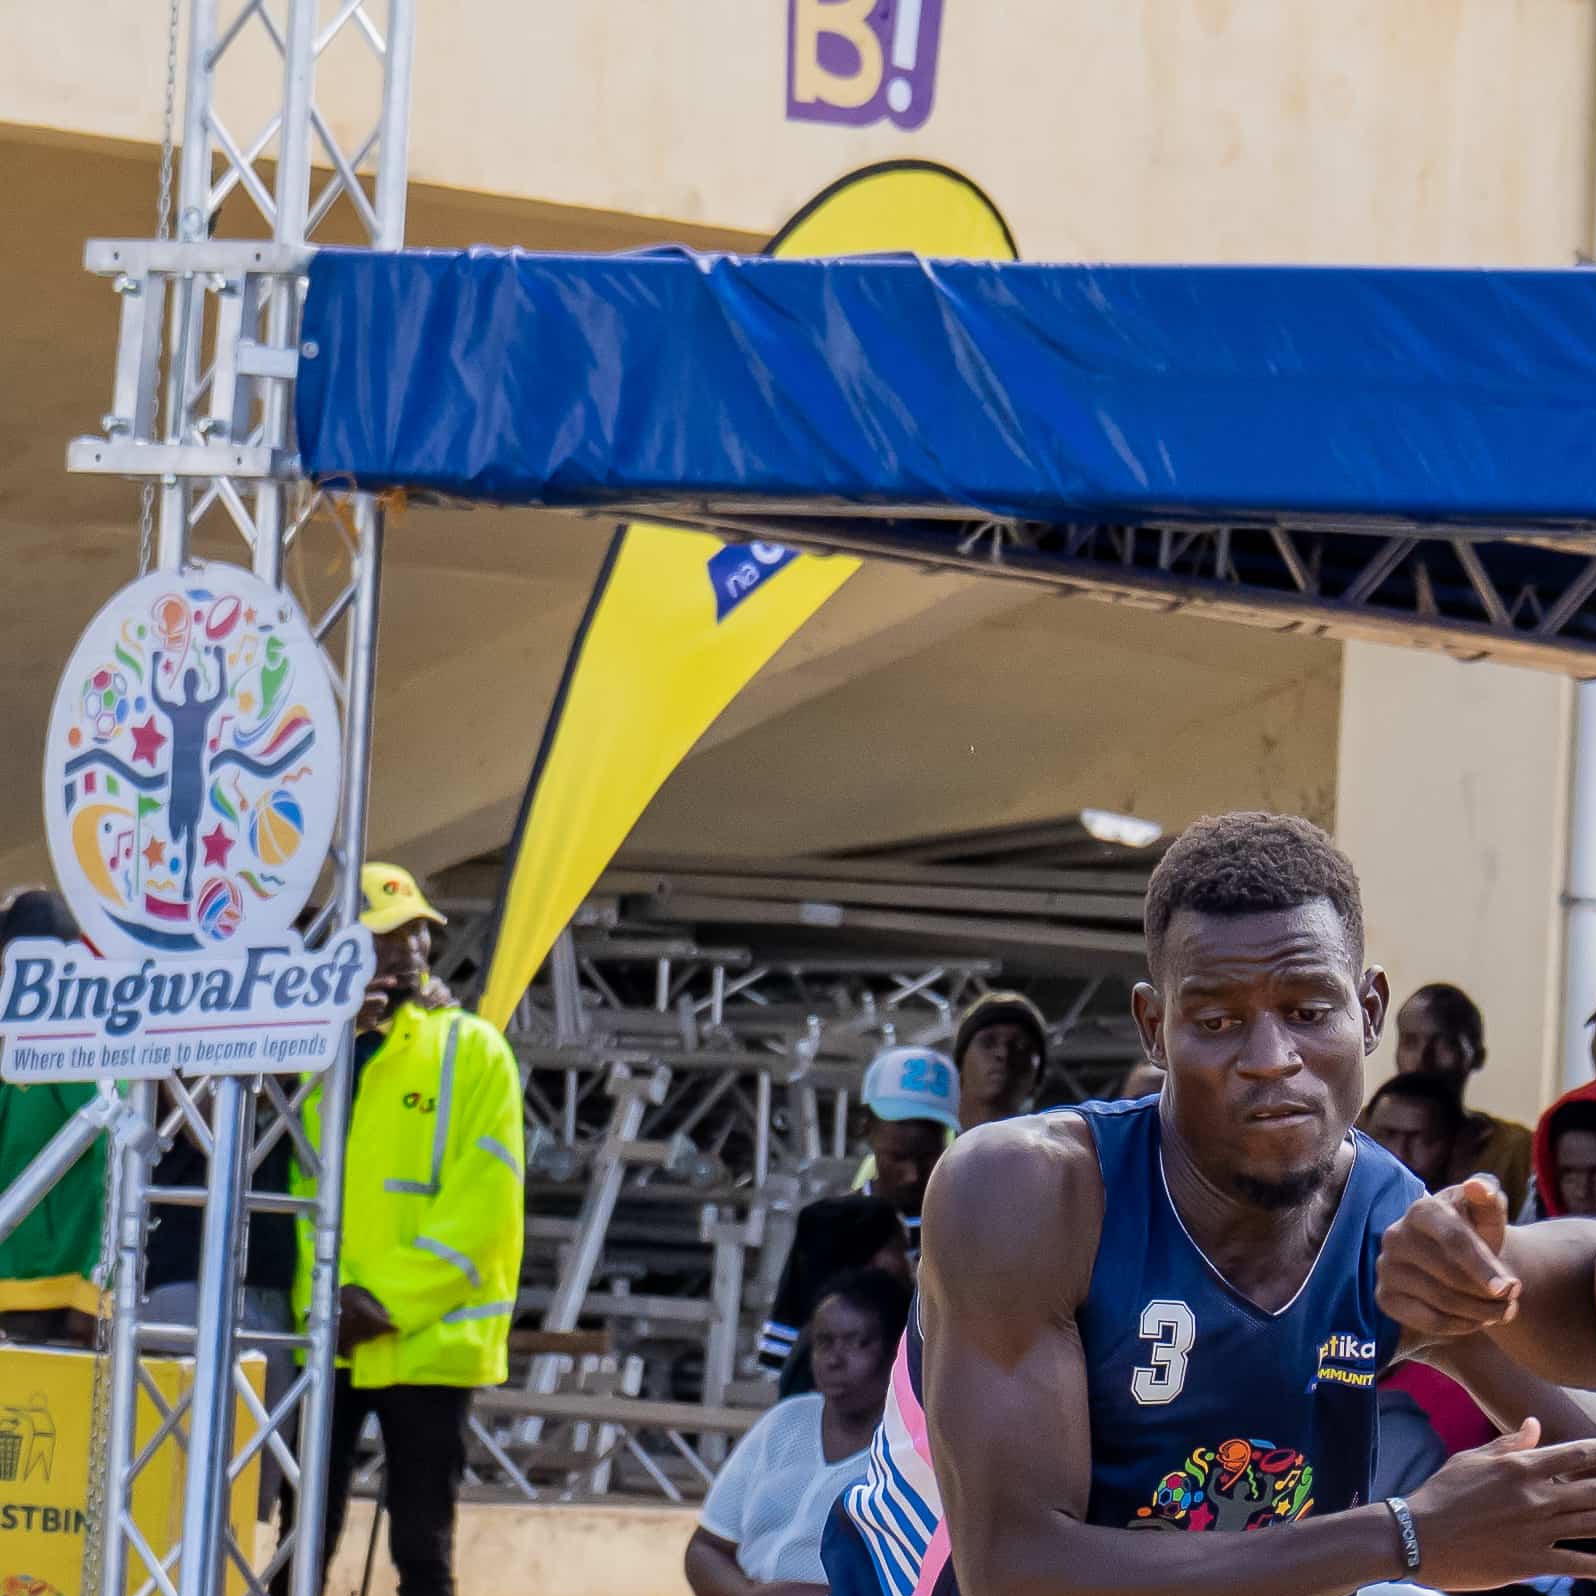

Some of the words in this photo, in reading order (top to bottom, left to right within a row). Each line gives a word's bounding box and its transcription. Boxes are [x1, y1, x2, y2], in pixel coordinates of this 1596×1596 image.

[1, 938, 363, 1038] BingwaFest
[14, 1046, 65, 1071] Where
[71, 1043, 97, 1067] the
[101, 1041, 136, 1067] best
[142, 1043, 171, 1065] rise
[177, 1041, 191, 1063] to
[196, 1040, 257, 1065] become
[262, 1032, 328, 1058] legends
[1131, 1299, 1197, 1405] 3
[1318, 1367, 1375, 1388] MMUNIT
